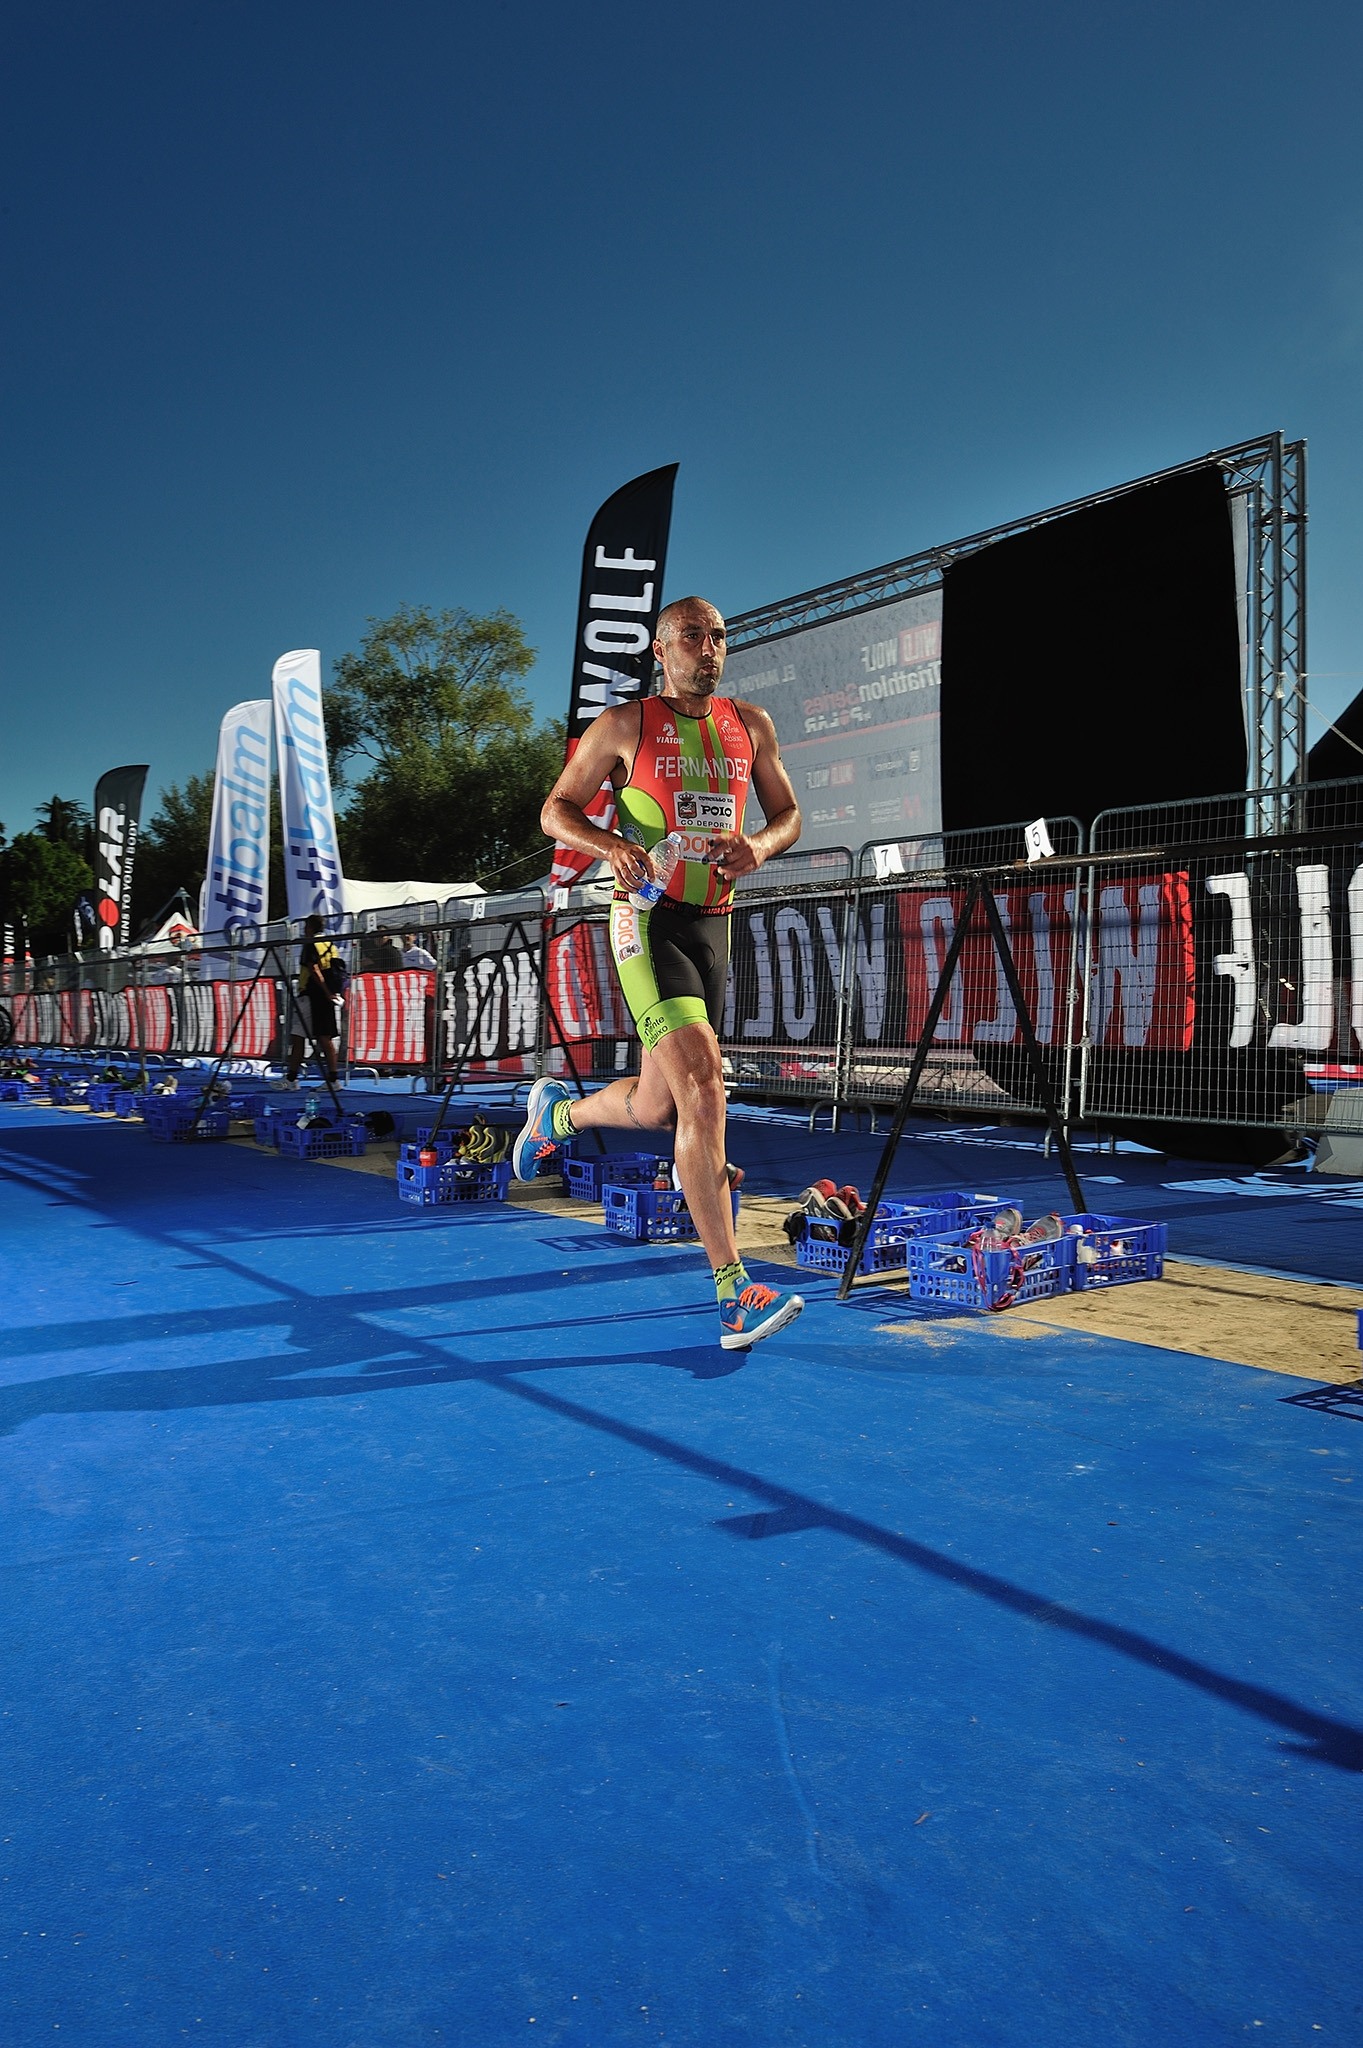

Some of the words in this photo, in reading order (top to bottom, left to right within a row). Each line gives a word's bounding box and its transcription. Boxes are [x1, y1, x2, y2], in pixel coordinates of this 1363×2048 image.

[576, 545, 656, 719] WOLF
[656, 736, 684, 745] VIATOR
[655, 756, 749, 783] FERNANDEZ
[701, 804, 732, 817] POIO
[697, 820, 733, 830] DEPORTE
[126, 819, 138, 854] BODY
[1031, 826, 1041, 848] 5
[880, 849, 889, 866] 7
[122, 857, 135, 891] YOUR
